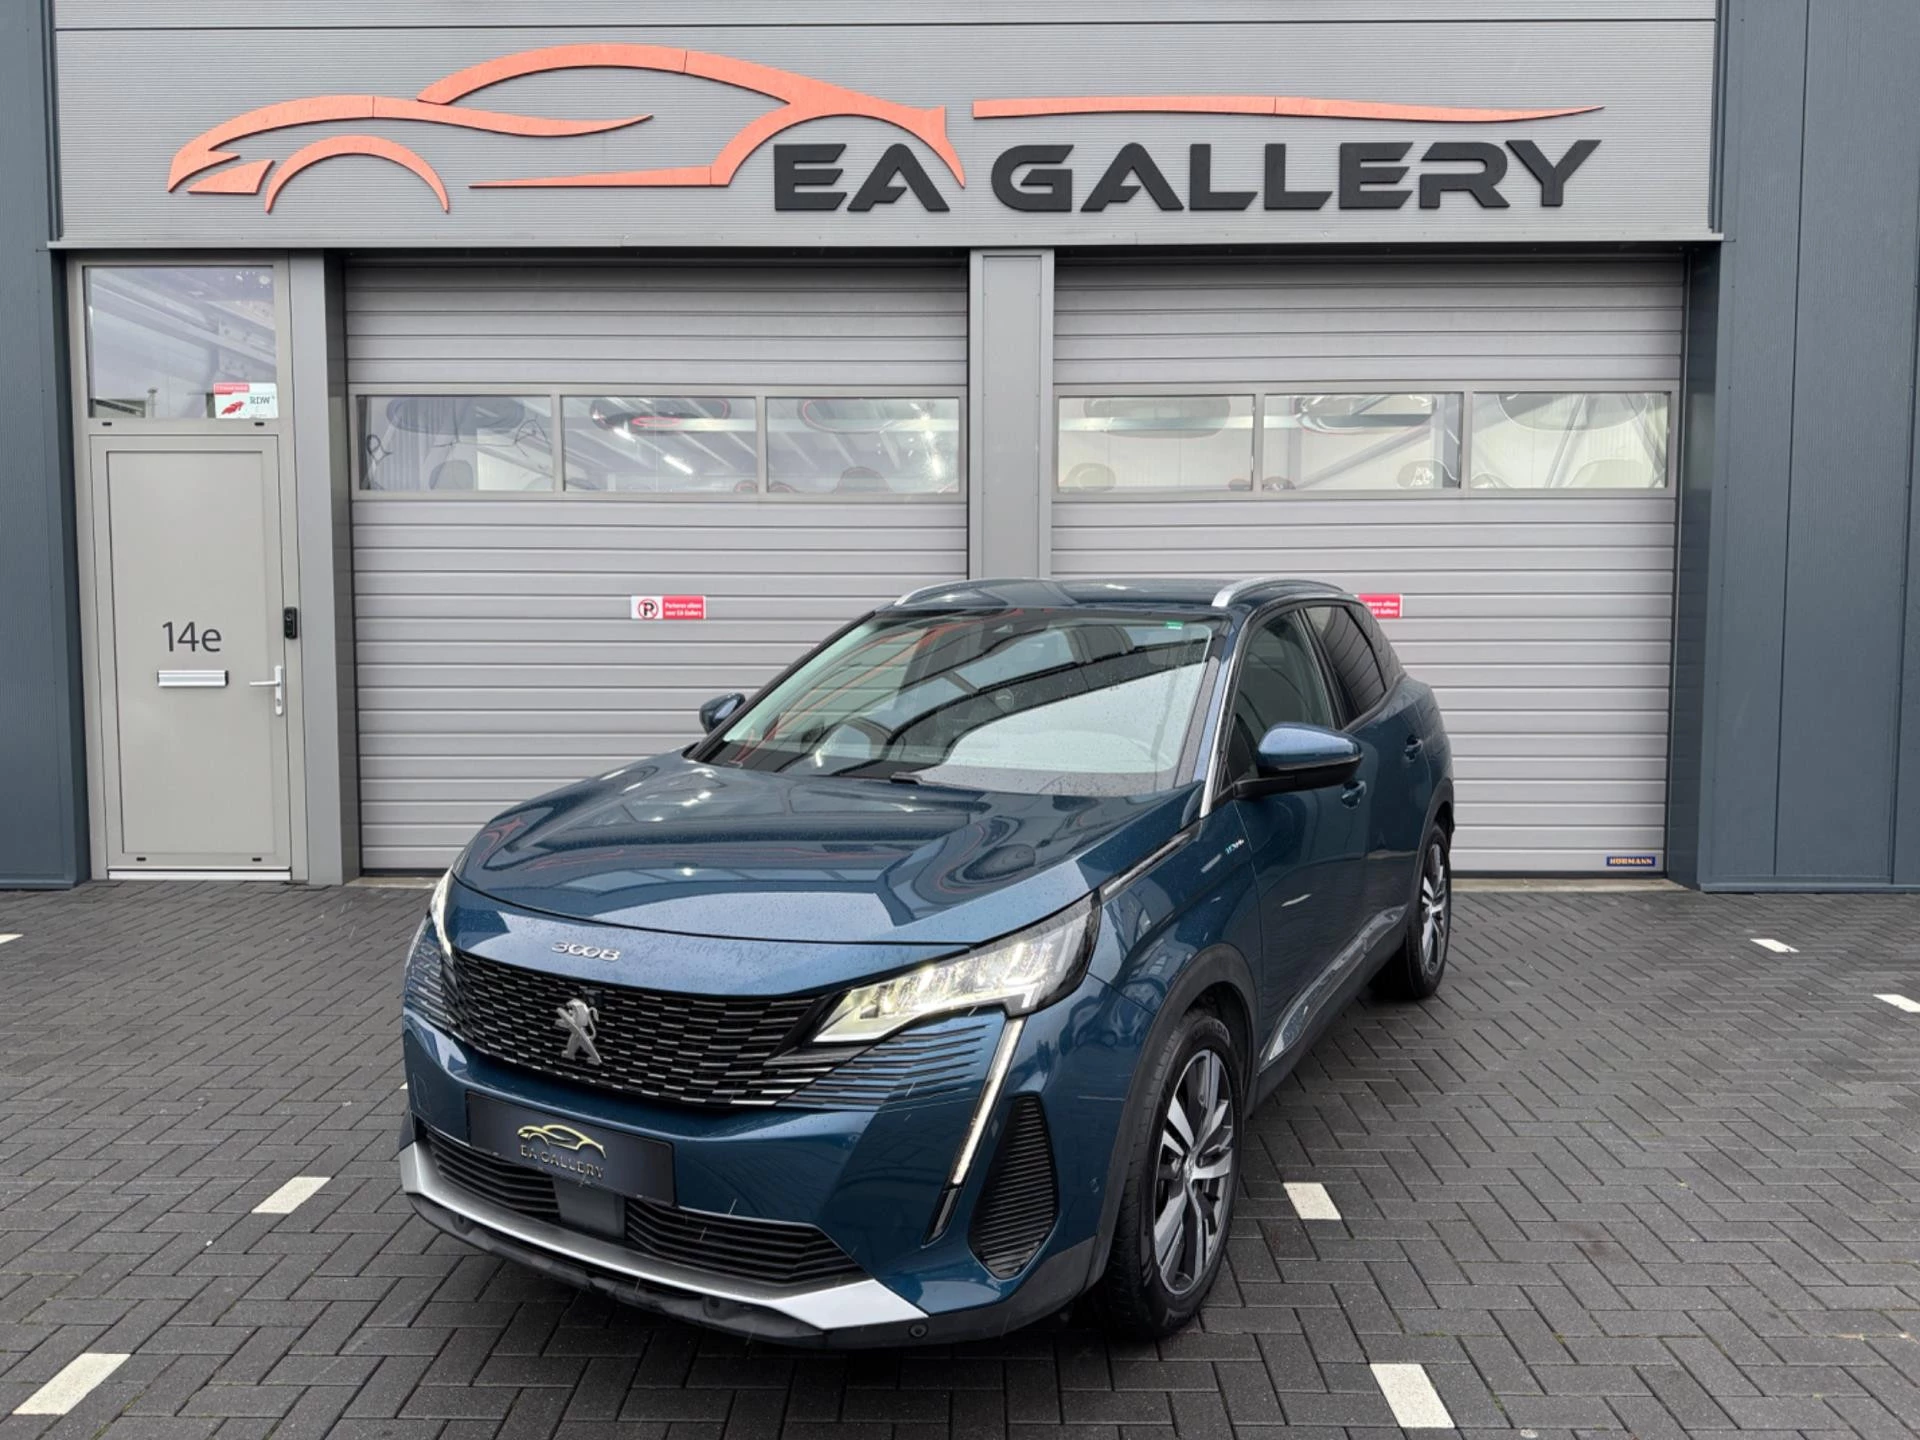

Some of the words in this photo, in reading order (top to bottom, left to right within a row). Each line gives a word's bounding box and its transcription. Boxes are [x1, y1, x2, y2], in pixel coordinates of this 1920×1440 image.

[773, 143, 950, 212] EA
[990, 139, 1602, 212] GALLERY
[162, 621, 222, 653] 14e
[551, 941, 621, 962] 3008
[520, 1144, 538, 1160] EA
